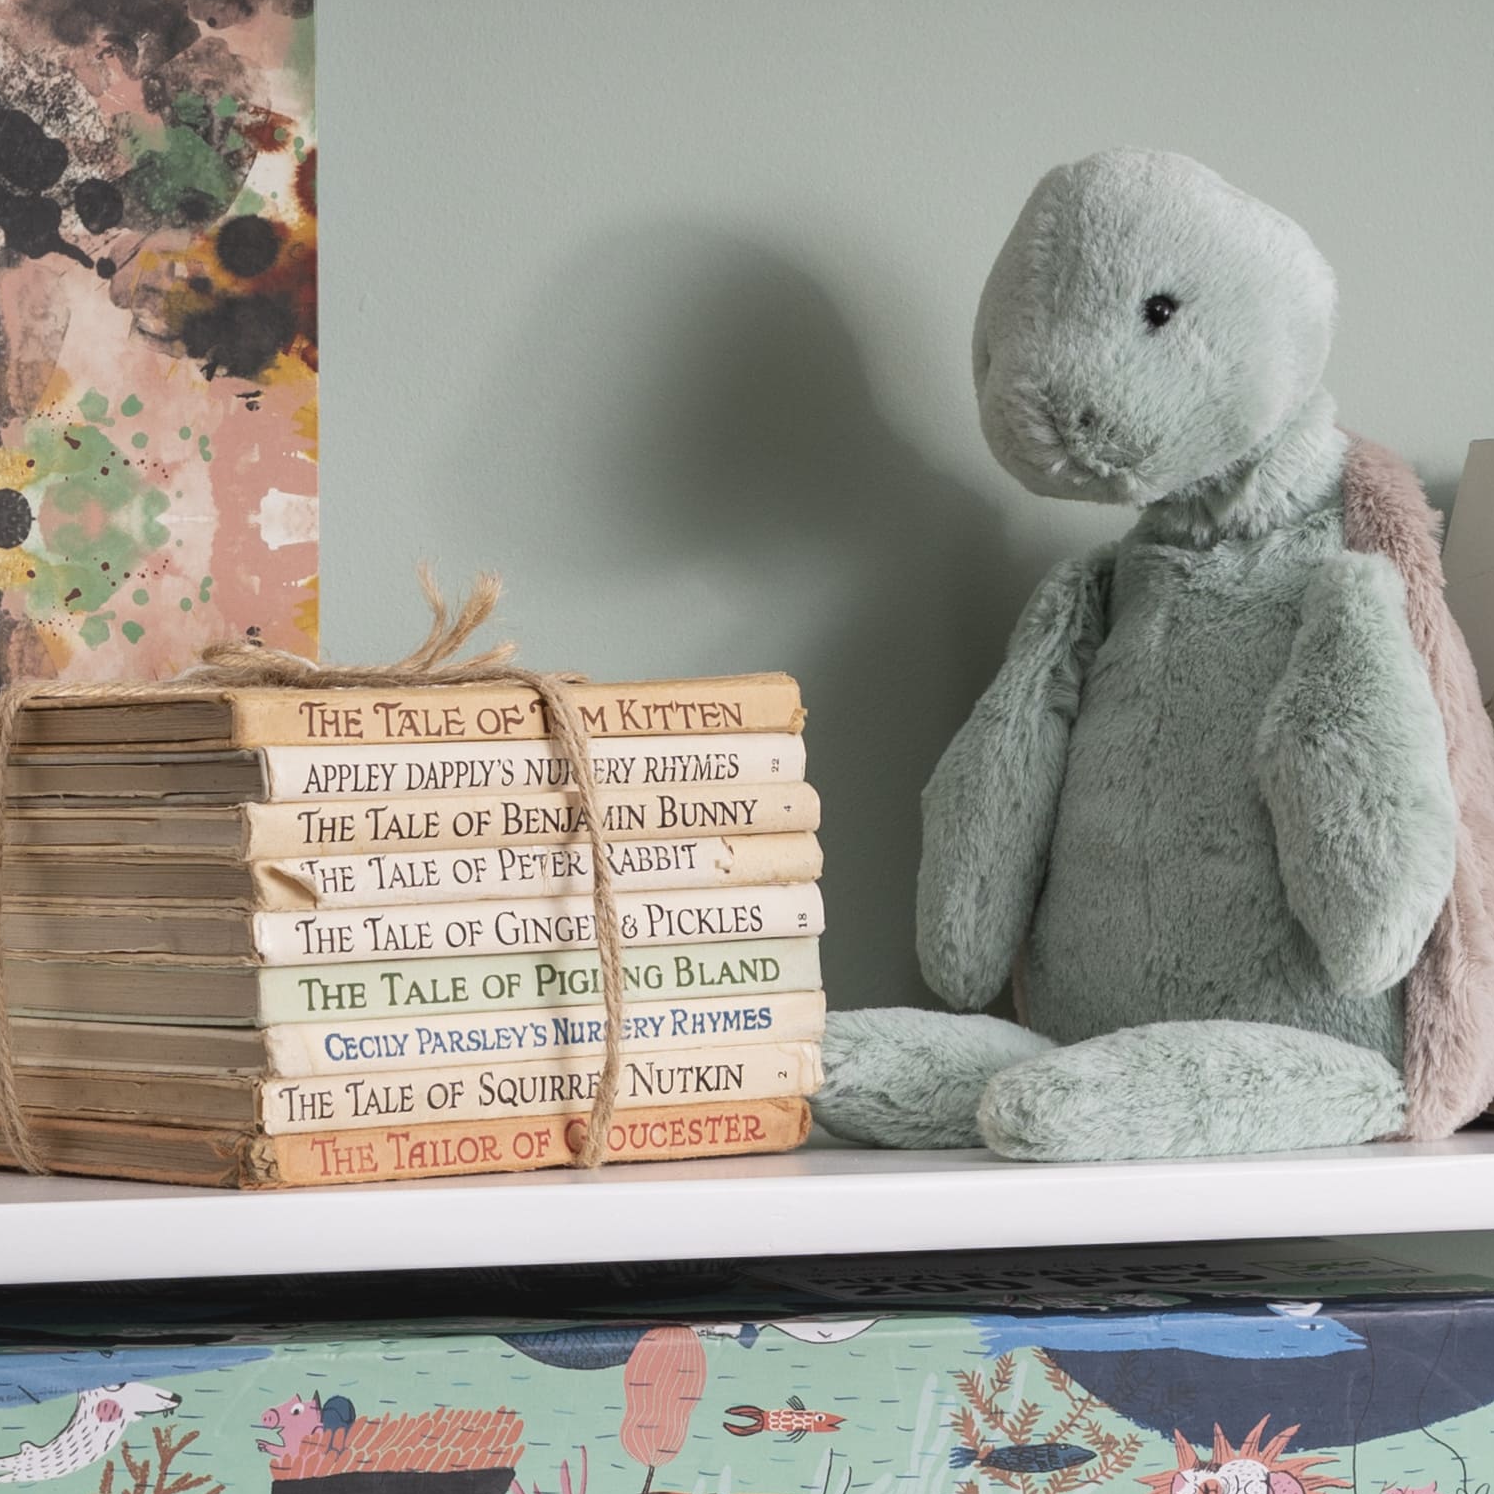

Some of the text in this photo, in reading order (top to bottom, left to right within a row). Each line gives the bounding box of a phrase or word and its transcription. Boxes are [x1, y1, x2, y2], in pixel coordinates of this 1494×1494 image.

[299, 698, 744, 739] THE TALE OF TM KITTEN
[302, 763, 398, 794] APPLEY
[523, 756, 636, 786] NURERY
[643, 753, 740, 785] RHYMES
[297, 807, 356, 844] THE
[365, 805, 440, 841] TALE
[452, 810, 492, 837] OF
[656, 795, 759, 829] BUNNY
[368, 855, 441, 890] TALE
[452, 857, 488, 885] OF
[497, 848, 588, 882] PETER
[295, 916, 355, 955] THE
[363, 914, 434, 952] TALE
[445, 920, 484, 948] OF
[621, 914, 639, 939] &
[642, 903, 764, 939] PICKLES
[298, 956, 780, 1011] THE TALE OF PIGLNG BLAND
[324, 1032, 410, 1062] CECILY
[551, 1015, 667, 1046] NURERY
[670, 1006, 773, 1037] RHYMES
[279, 1062, 745, 1122] THE TALE OF SQUIRRE NUTKIN
[311, 1114, 767, 1177] THE TAILOR OF GOUCESTER
